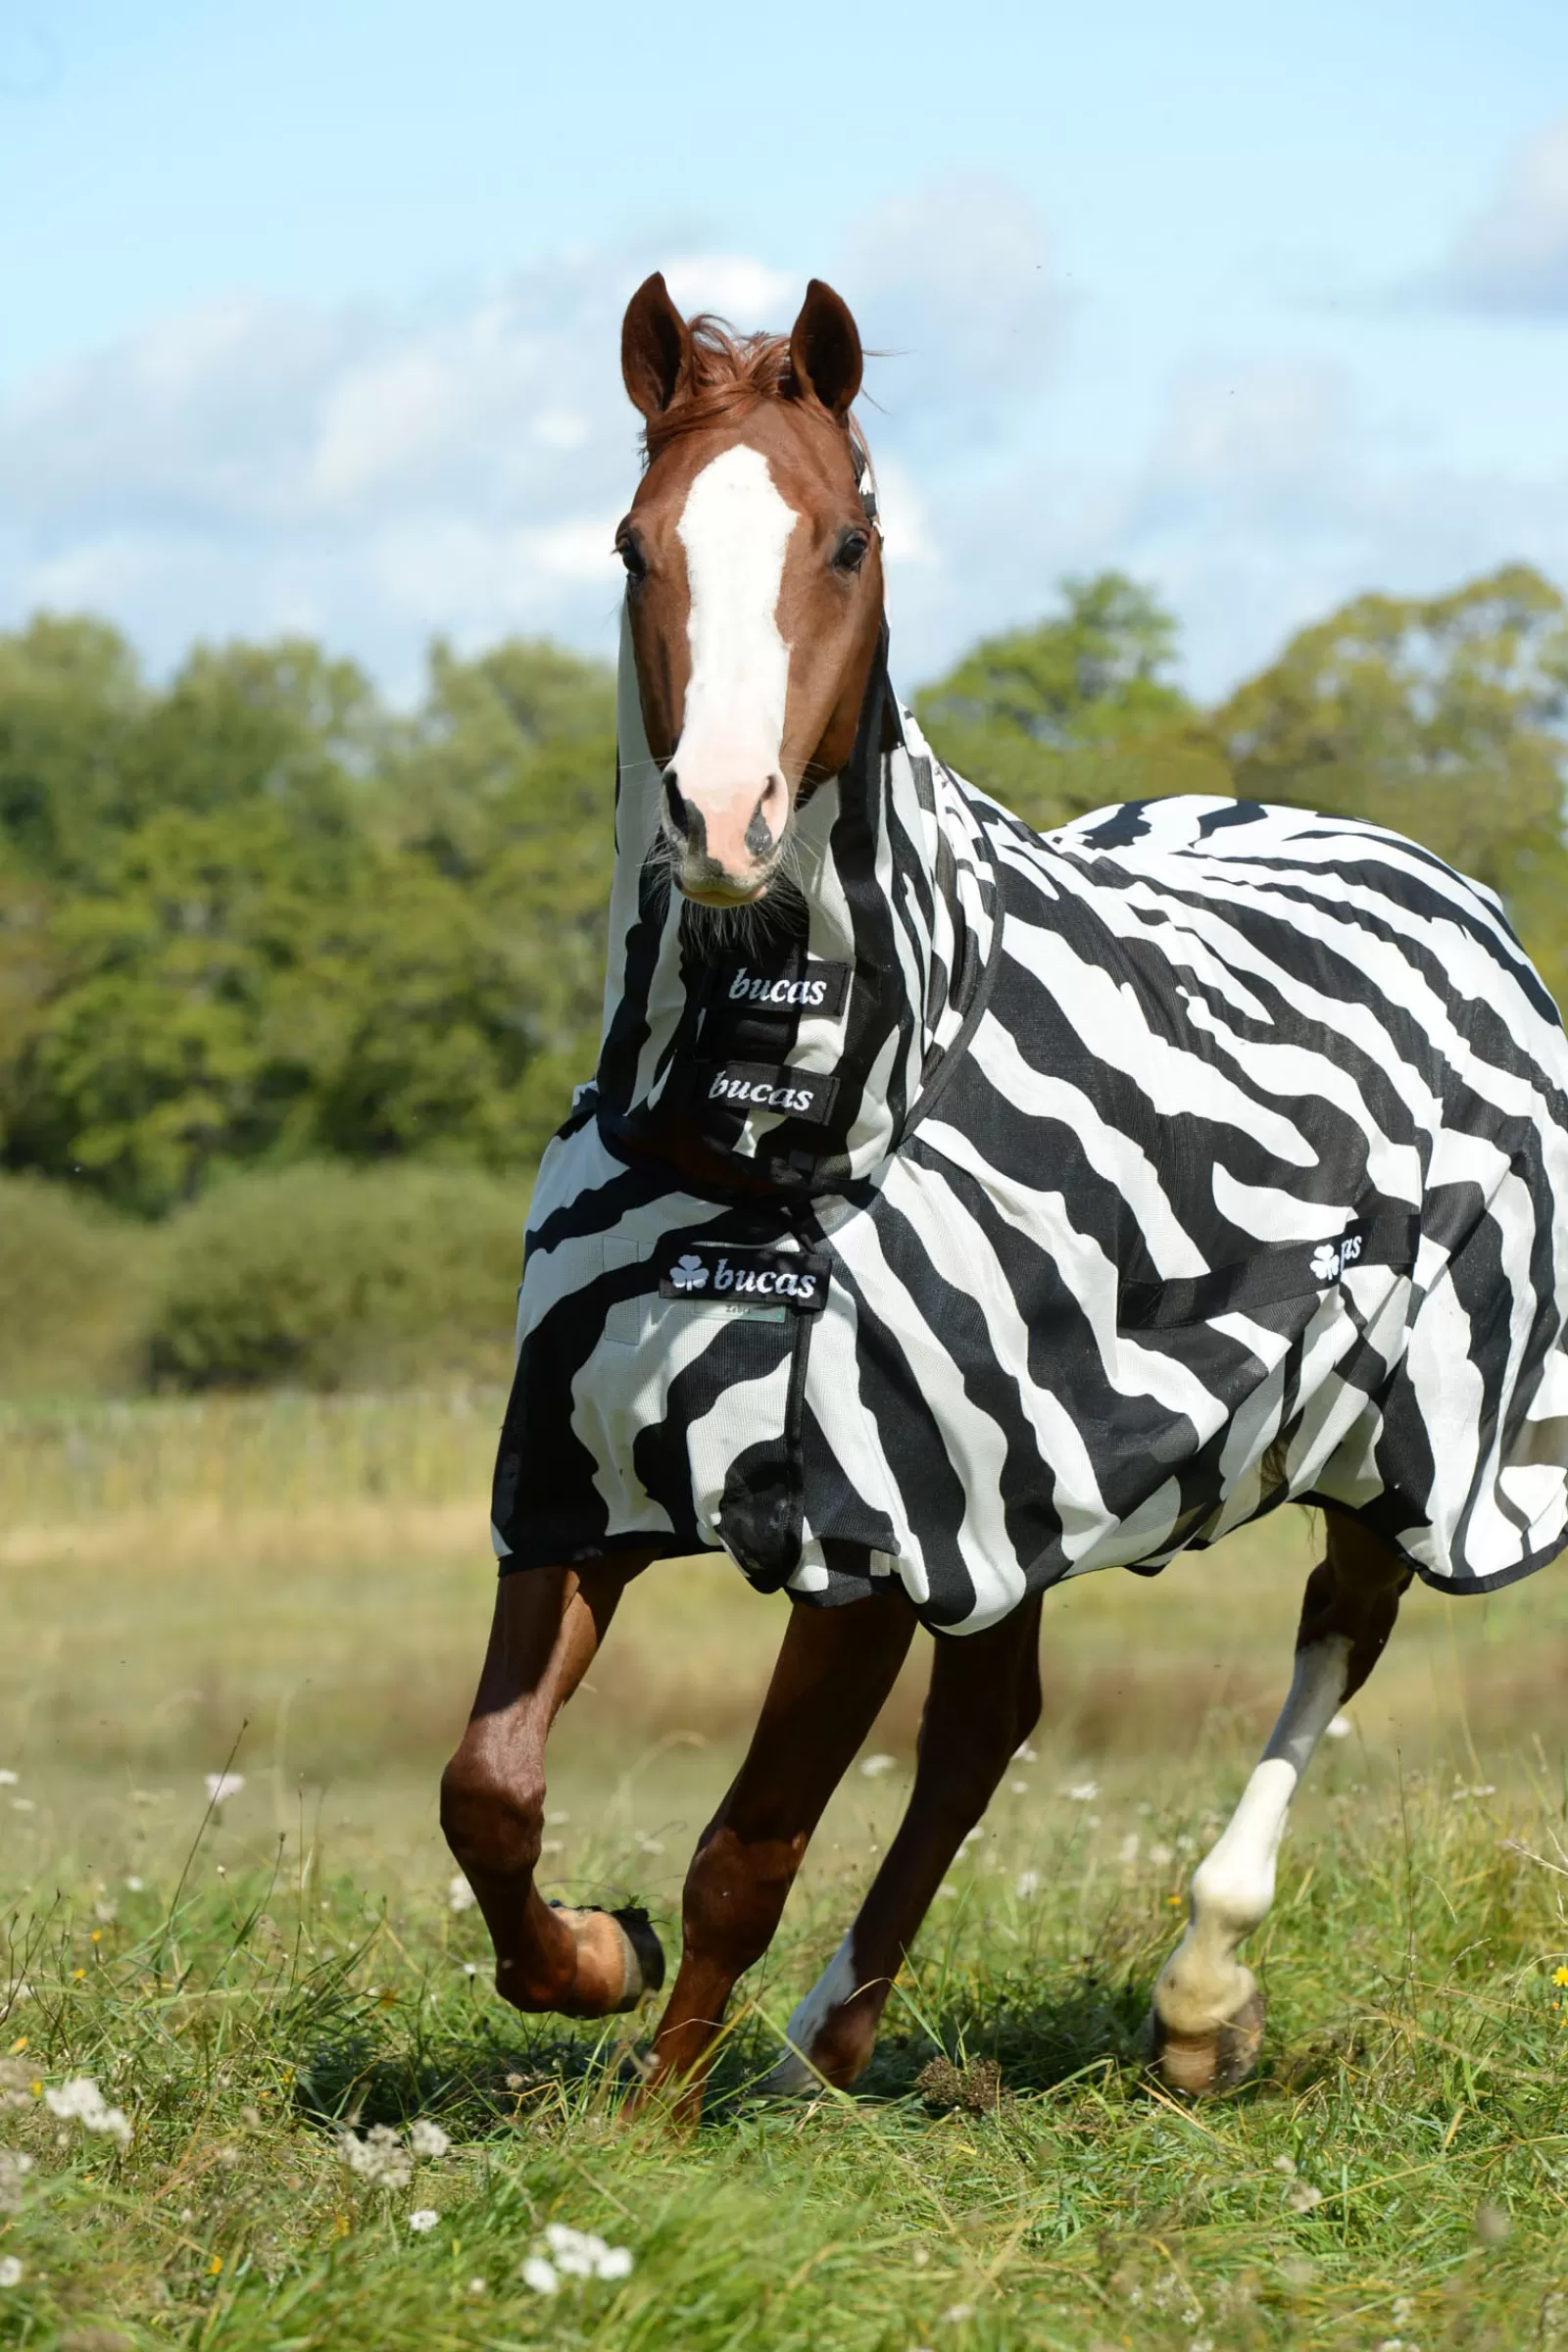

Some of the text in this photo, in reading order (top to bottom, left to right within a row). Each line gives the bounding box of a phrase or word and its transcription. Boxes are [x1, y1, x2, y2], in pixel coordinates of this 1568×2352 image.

[728, 967, 827, 1005] bucas
[708, 1070, 814, 1111] bucas
[713, 1258, 816, 1298] bucas
